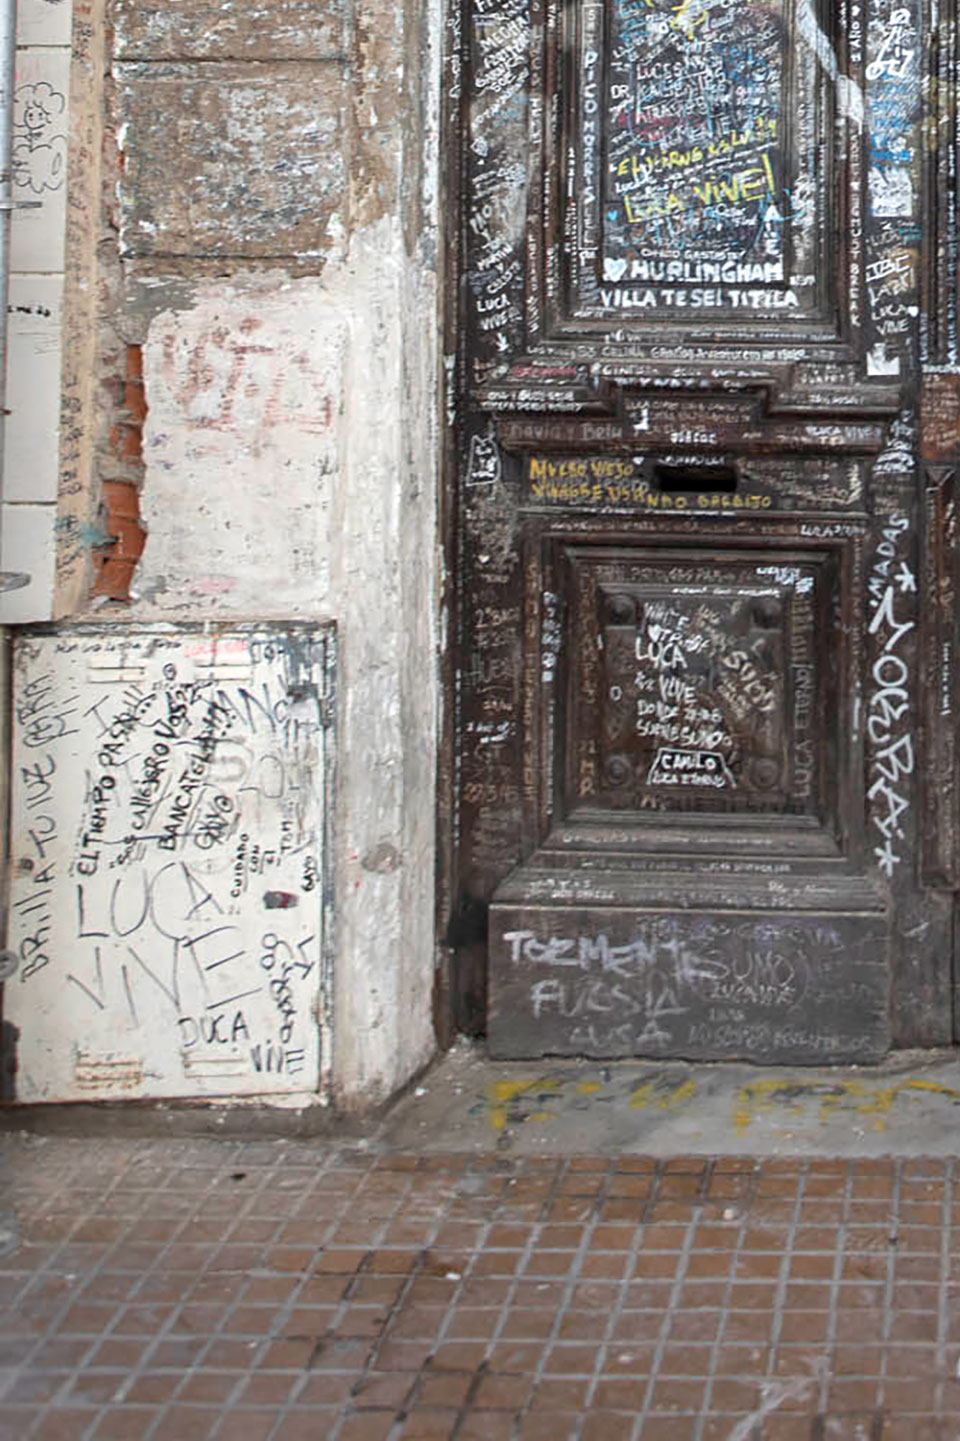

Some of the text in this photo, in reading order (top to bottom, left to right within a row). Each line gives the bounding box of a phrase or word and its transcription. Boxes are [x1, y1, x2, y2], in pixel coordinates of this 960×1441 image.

[631, 259, 784, 283] HURLINGHAM
[477, 293, 511, 312] LUCA
[600, 289, 657, 308] VILLA
[635, 636, 688, 668] LUCA
[77, 860, 225, 942] LUCA
